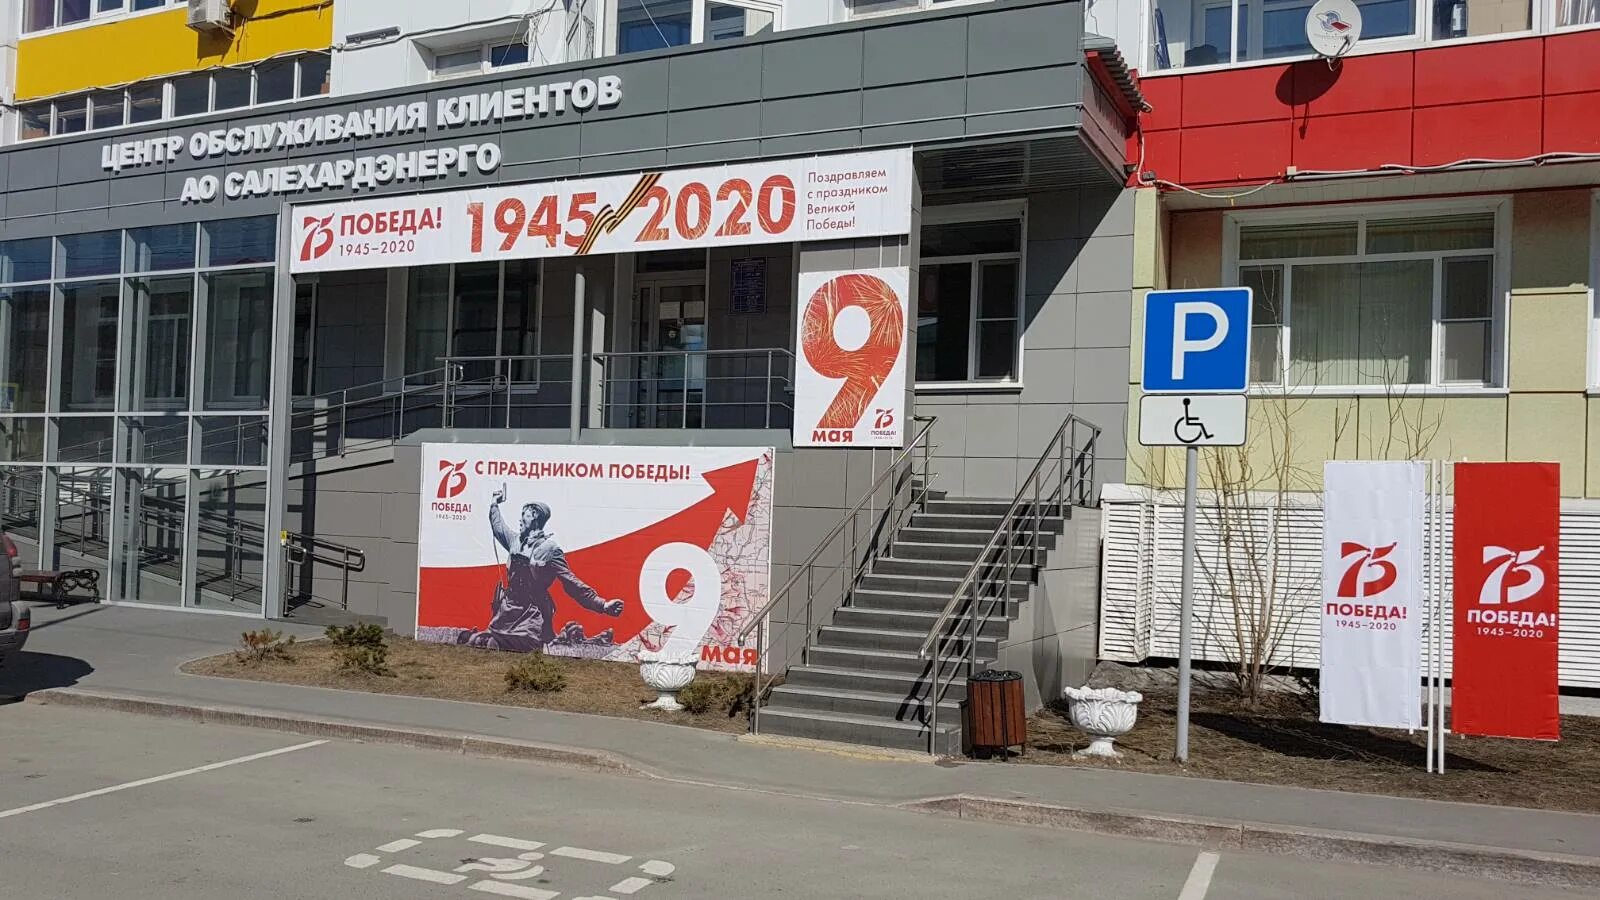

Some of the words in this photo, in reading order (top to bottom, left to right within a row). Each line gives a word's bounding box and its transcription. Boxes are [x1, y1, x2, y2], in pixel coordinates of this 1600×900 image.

[101, 135, 184, 173] ЦЕНТР
[189, 101, 427, 158] ОБСЛУЖИВАНИЯ
[436, 75, 623, 127] КЛИЕНТОВ
[180, 174, 219, 202] АО
[224, 142, 501, 198] САЛЕХАРДЭНЕРГО
[808, 169, 887, 184] Поздравляем
[807, 191, 814, 199] с
[816, 185, 888, 201] праздником
[467, 191, 597, 253] 1945
[634, 174, 796, 243] 2020
[807, 201, 855, 215] Великой
[340, 207, 442, 237] ПОБЕДА!
[807, 216, 856, 231] Победы!
[801, 273, 904, 429] 9
[1171, 301, 1230, 381] P
[811, 430, 853, 443] мая
[475, 461, 484, 475] С
[488, 461, 604, 479] ПРАЗДНИКОМ
[608, 463, 691, 482] ПОБЕДЫ!
[431, 502, 472, 514] ПОБЕДА!
[1337, 541, 1397, 598] 75
[1479, 545, 1545, 605] 75
[639, 541, 721, 656] 9
[1326, 603, 1407, 621] ПОБЕДА!
[1467, 609, 1556, 629] ПОБЕДА!
